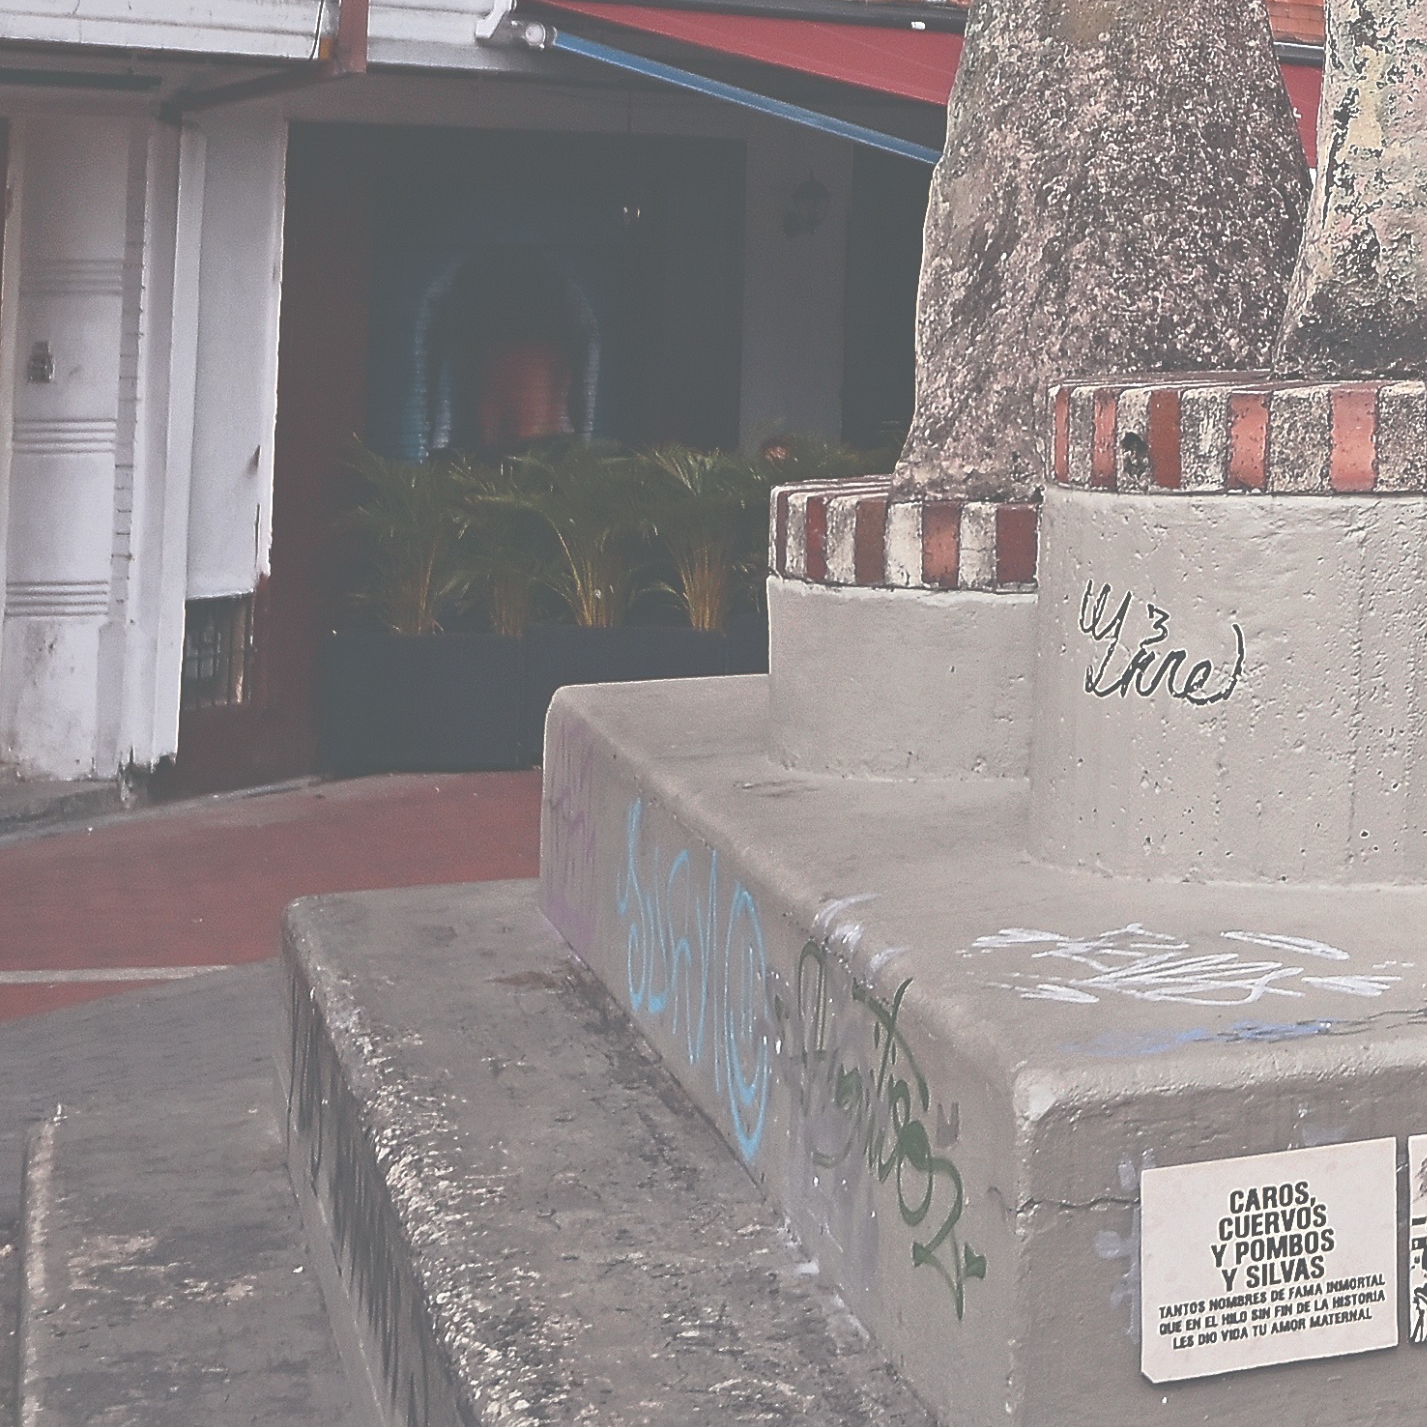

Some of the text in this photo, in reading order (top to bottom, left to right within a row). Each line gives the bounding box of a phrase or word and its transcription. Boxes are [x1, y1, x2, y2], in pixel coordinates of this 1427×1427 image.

[1229, 1181, 1316, 1214] CAROS,
[1218, 1204, 1327, 1241] CUERVOS
[1210, 1228, 1335, 1268] Y POMBOS
[1221, 1255, 1325, 1292] Y SILVAS
[1159, 1273, 1386, 1319] TANTOS NOMBRES DE FAMA INMORTAL
[1159, 1289, 1386, 1336] QUE EN EL HILO SIN FIN DE LA HISTORIA
[1172, 1307, 1373, 1350] LES DIO VIDA TU AMOR MATERNAL
